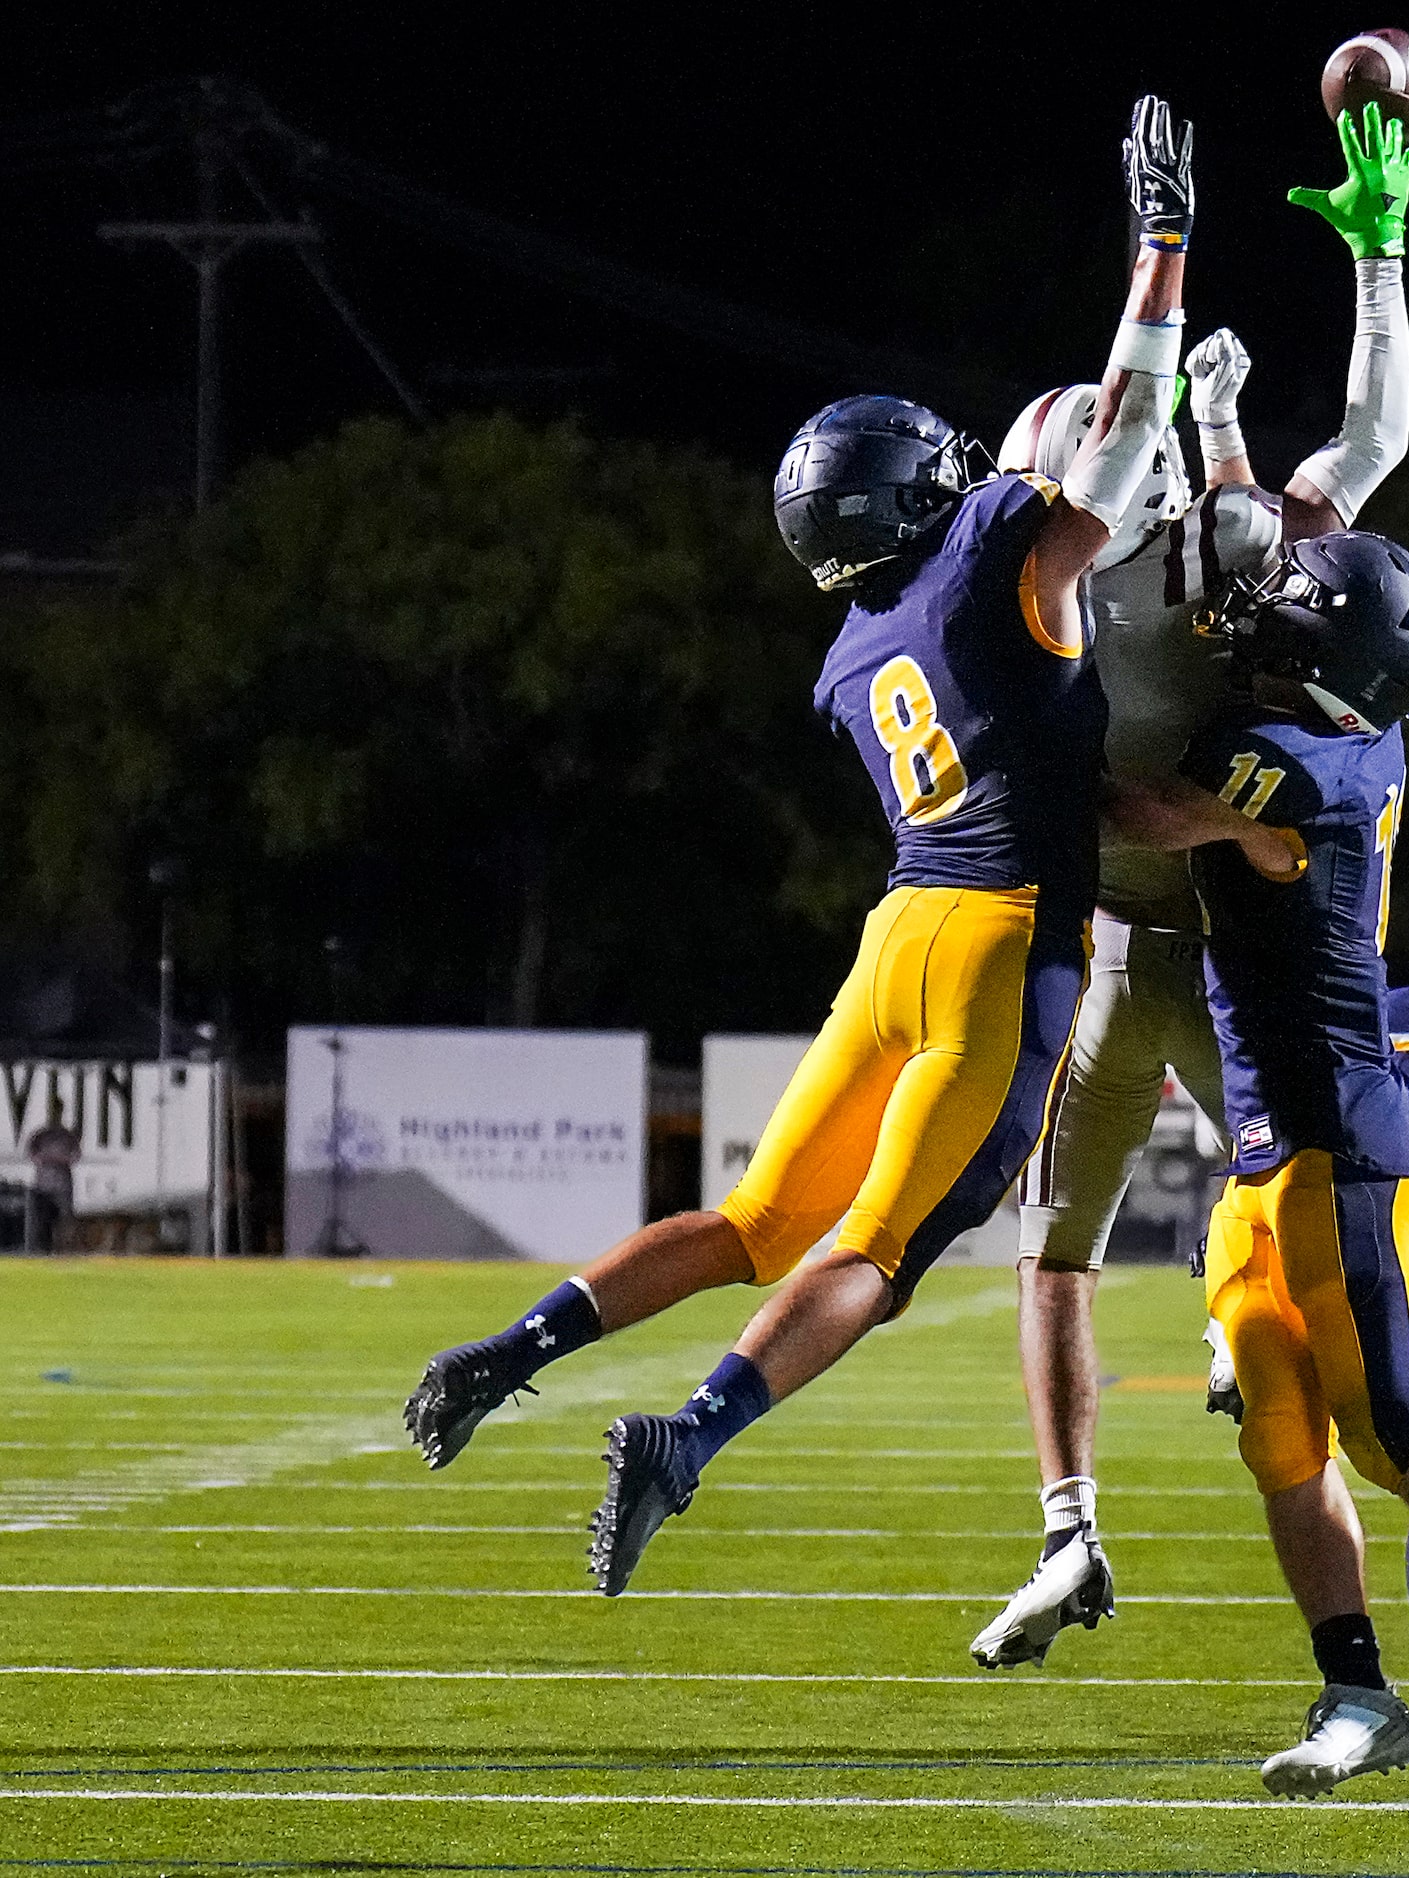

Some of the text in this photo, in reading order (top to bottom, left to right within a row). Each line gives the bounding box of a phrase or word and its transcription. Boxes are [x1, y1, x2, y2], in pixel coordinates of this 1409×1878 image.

[869, 654, 968, 826] 8
[1218, 751, 1286, 820] 11
[401, 1118, 625, 1143] Highland Park
